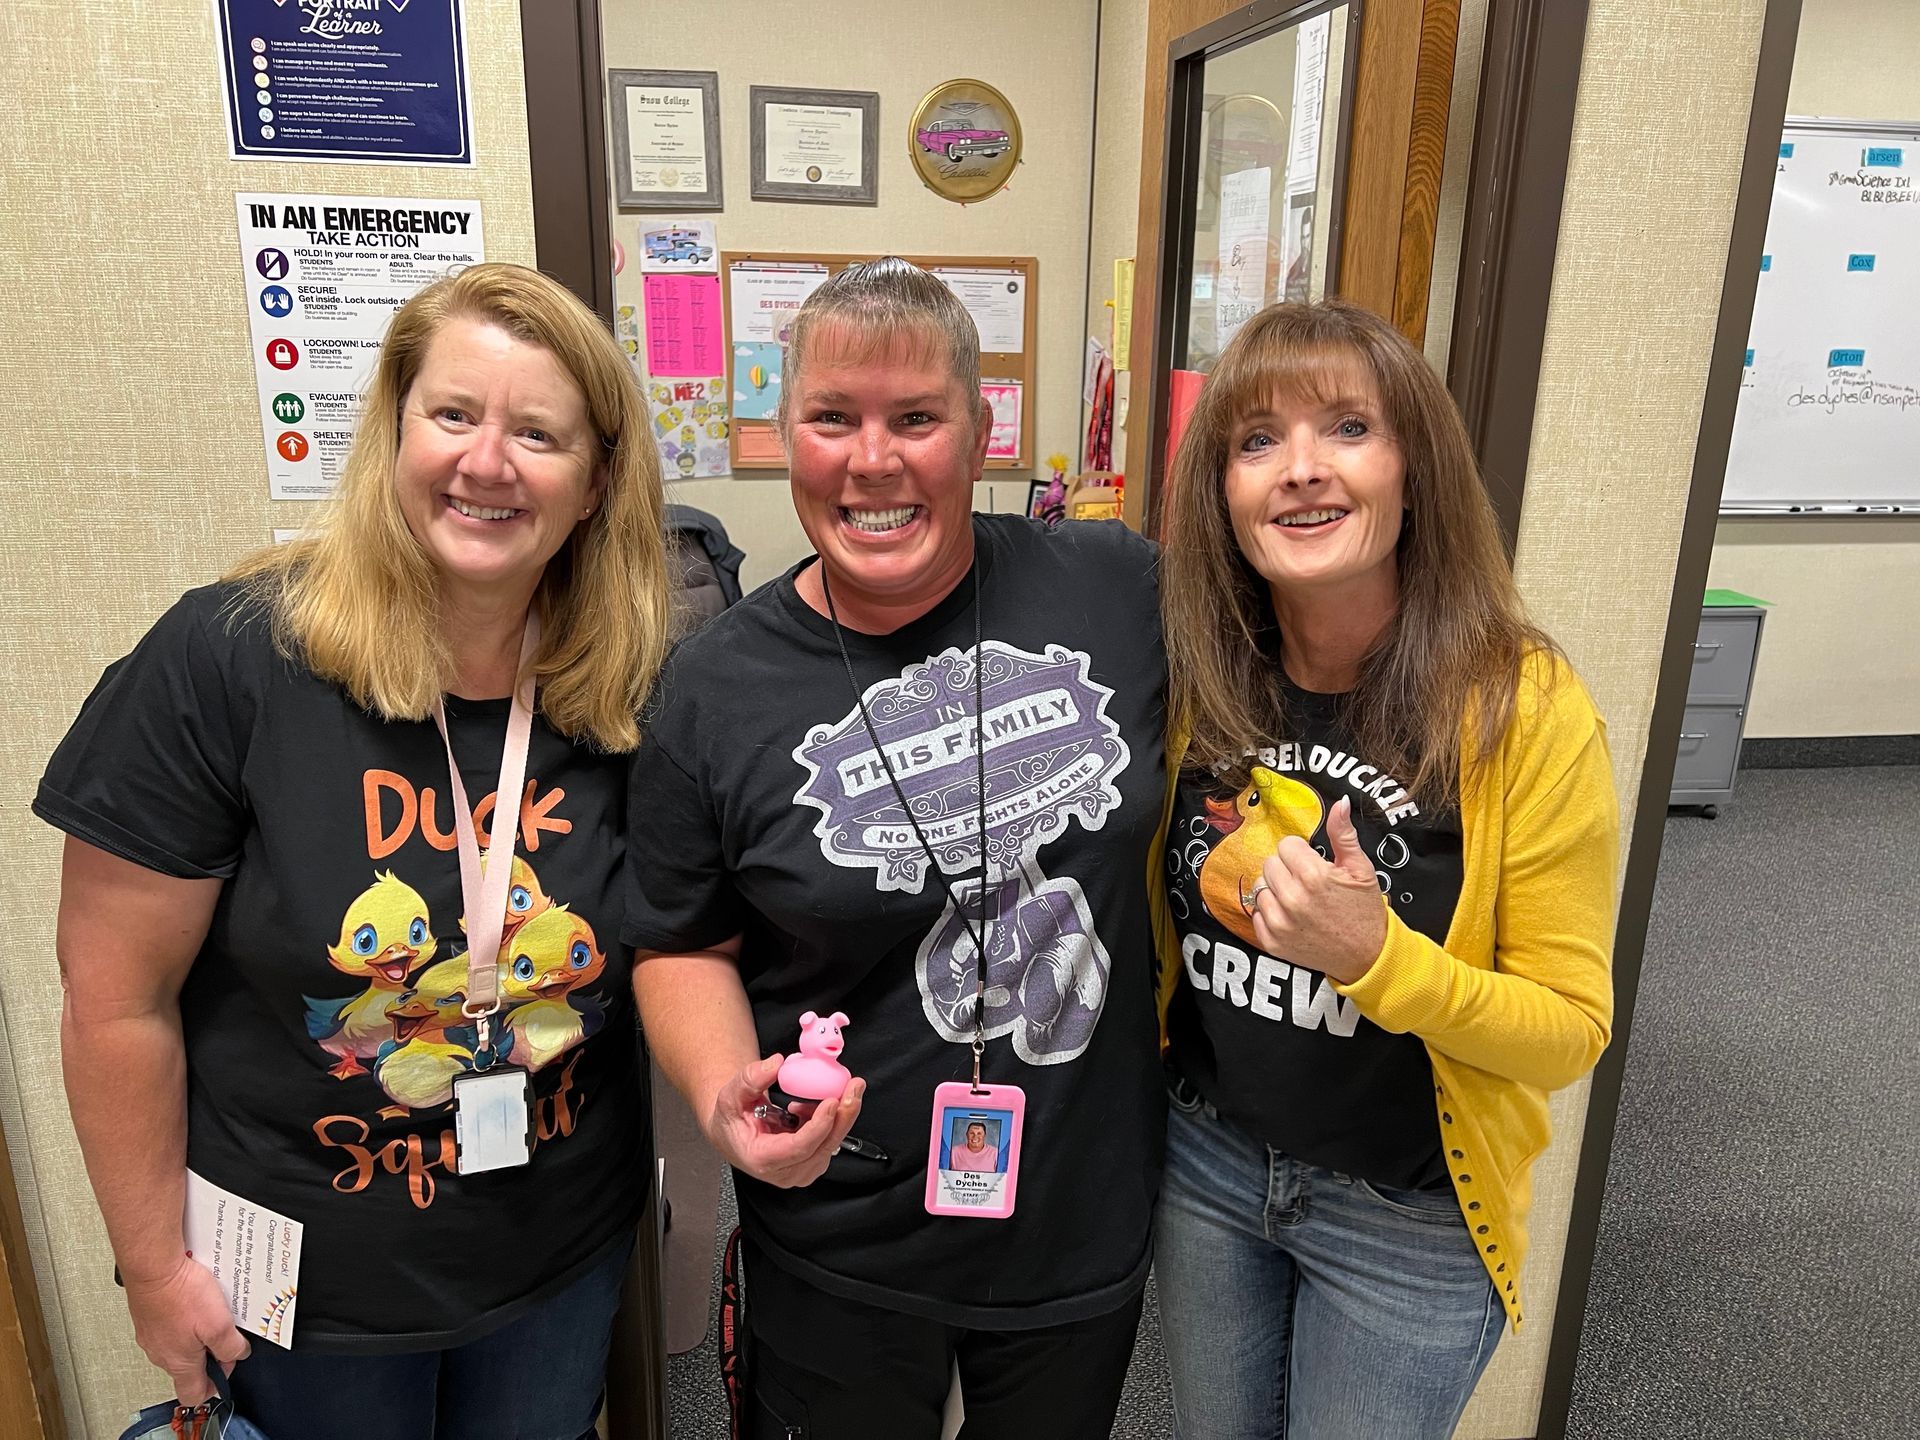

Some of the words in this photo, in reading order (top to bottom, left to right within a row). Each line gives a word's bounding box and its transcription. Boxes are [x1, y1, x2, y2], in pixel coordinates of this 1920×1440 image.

[300, 4, 383, 40] Learner
[334, 10, 344, 20] of
[663, 96, 690, 107] College
[250, 204, 276, 228] IN
[282, 206, 316, 230] AN
[324, 207, 470, 235] EMERGENCY
[306, 231, 351, 246] TAKE
[355, 233, 420, 248] ACTION
[294, 249, 322, 257] HOLD!
[1851, 256, 1871, 267] Cox
[298, 286, 337, 294] SECURE!
[304, 339, 359, 347] LOCKDOWN!
[1833, 351, 1862, 362] Orton
[309, 393, 357, 401] EVACUATE!
[936, 701, 966, 724] IN
[846, 745, 934, 788] THIS
[942, 697, 1070, 756] FAMILY
[1309, 744, 1420, 827] DUCKIE
[914, 824, 957, 842] ONE
[1036, 762, 1093, 802] ALONE
[1182, 933, 1360, 1037] CREW
[217, 1199, 225, 1226] Thanks
[248, 1212, 256, 1227] You
[237, 1218, 245, 1230] the
[235, 1233, 243, 1256] month
[280, 1222, 293, 1249] Lucky
[245, 1243, 254, 1254] the
[265, 1219, 277, 1284] Congratulations!!
[234, 1258, 242, 1266] of
[243, 1256, 252, 1275] lucky
[280, 1250, 291, 1277] Duck!
[213, 1266, 221, 1279] do!
[232, 1267, 241, 1315] September!!!
[243, 1277, 251, 1295] duck
